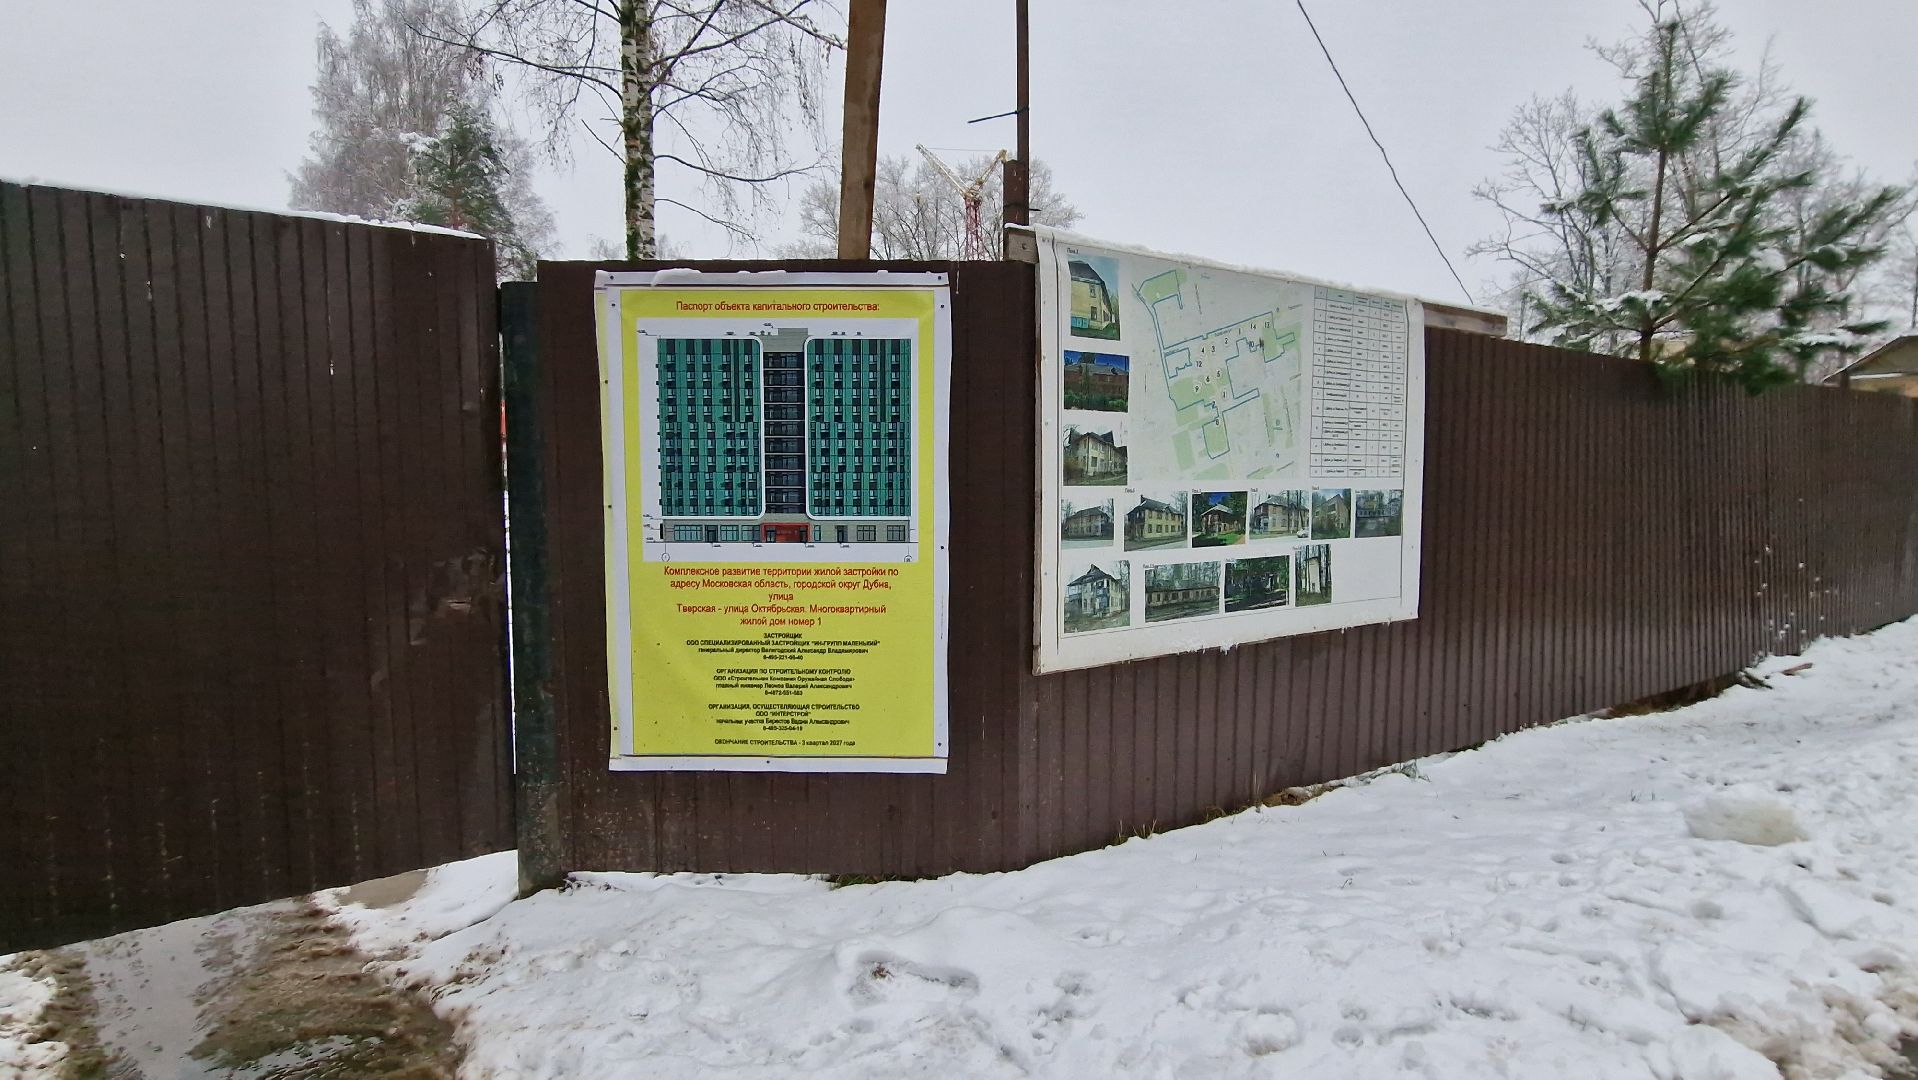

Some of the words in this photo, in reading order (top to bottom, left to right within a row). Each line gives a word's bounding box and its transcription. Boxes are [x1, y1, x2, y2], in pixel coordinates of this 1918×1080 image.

[676, 301, 712, 313] Паспорт
[715, 301, 750, 311] объекта
[753, 301, 810, 312] капитального
[813, 302, 879, 313] строительства:
[664, 566, 719, 576] Комплексное
[722, 567, 760, 578] развитие
[763, 568, 811, 579] территории
[814, 567, 841, 576] жилой
[844, 567, 885, 579] застройки
[888, 569, 899, 577] по
[670, 581, 700, 591] адресу
[703, 579, 752, 589] Московская
[755, 579, 791, 589] область,
[794, 580, 836, 590] городской
[839, 581, 860, 591] округ
[863, 579, 891, 591] Дубна,
[768, 594, 793, 603] улица
[677, 604, 715, 615] Тверская
[724, 606, 748, 615] улица
[751, 605, 806, 616] Октябрьская.
[810, 604, 886, 616] Многоквартирный
[740, 617, 767, 626] жилой
[769, 619, 787, 628] дом
[788, 619, 815, 629] номер
[817, 617, 822, 626] 1
[701, 639, 771, 647] СПЕЦИАЛИЗИРОВАННЫЙ
[716, 668, 759, 676] ОРГАНИЗАЦИЯ
[769, 668, 818, 676] СТРОИТЕЛЬНОМУ
[819, 668, 852, 676] КОНТРОЛЮ
[811, 703, 860, 711] СТРОИТЕЛЬСТВО
